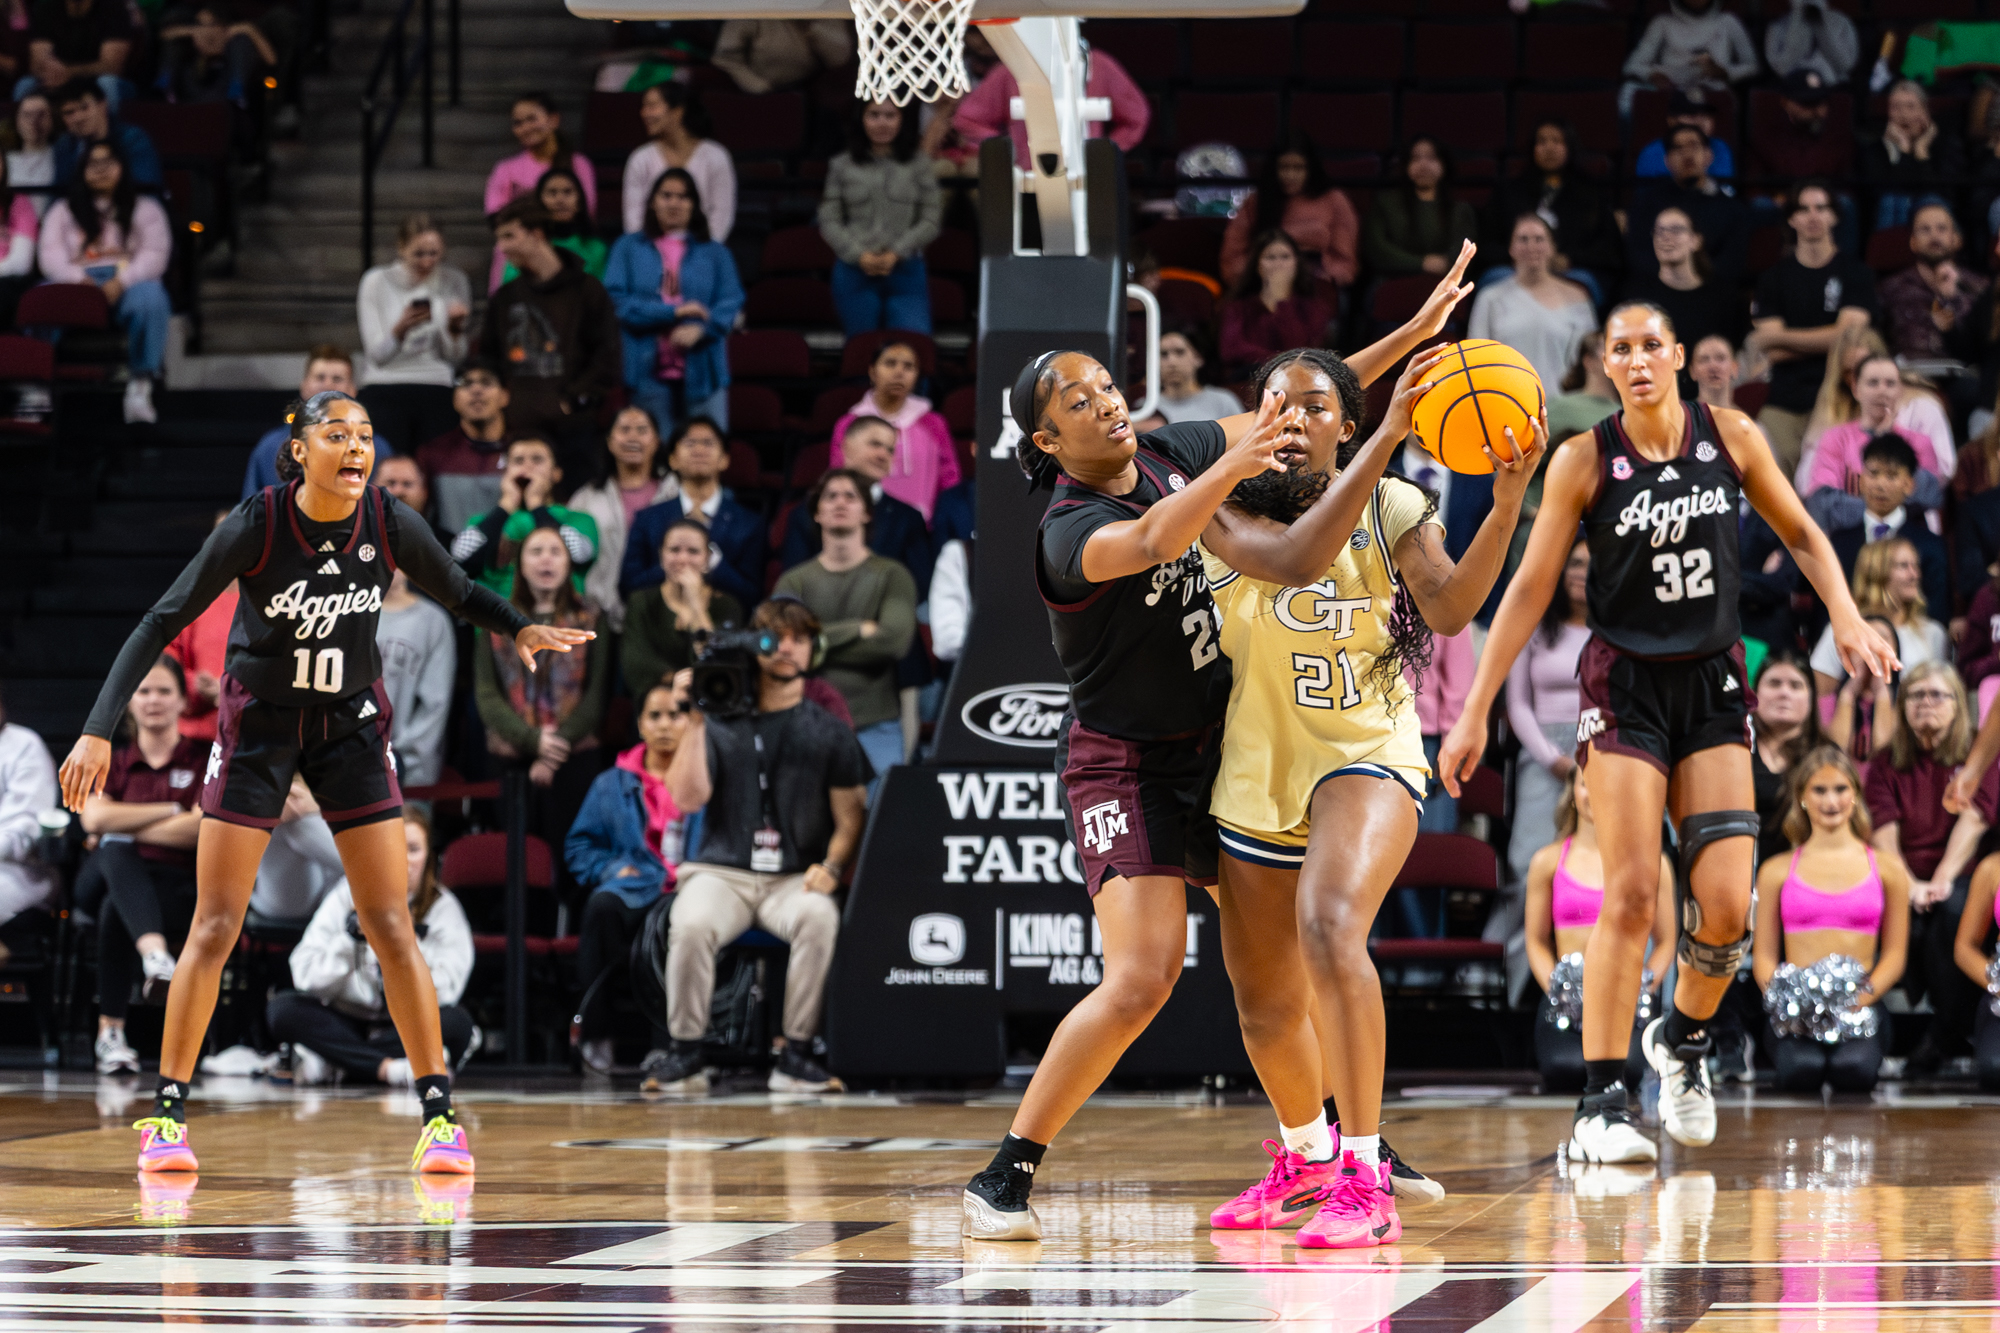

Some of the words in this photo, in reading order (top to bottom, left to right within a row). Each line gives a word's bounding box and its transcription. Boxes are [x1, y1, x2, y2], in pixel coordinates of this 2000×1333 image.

[1615, 485, 1731, 548] Aggies
[359, 544, 376, 562] SEC
[1652, 548, 1715, 602] 32
[264, 579, 382, 640] Aggies
[1274, 579, 1372, 640] GT
[1182, 603, 1223, 671] 2
[292, 647, 344, 693] 10
[1292, 648, 1362, 711] 21
[989, 691, 1069, 736] For
[937, 773, 1065, 819] WEL
[942, 835, 1085, 883] FAR
[1009, 913, 1084, 956] KING
[884, 967, 930, 985] JOHN
[933, 968, 989, 985] DEERE
